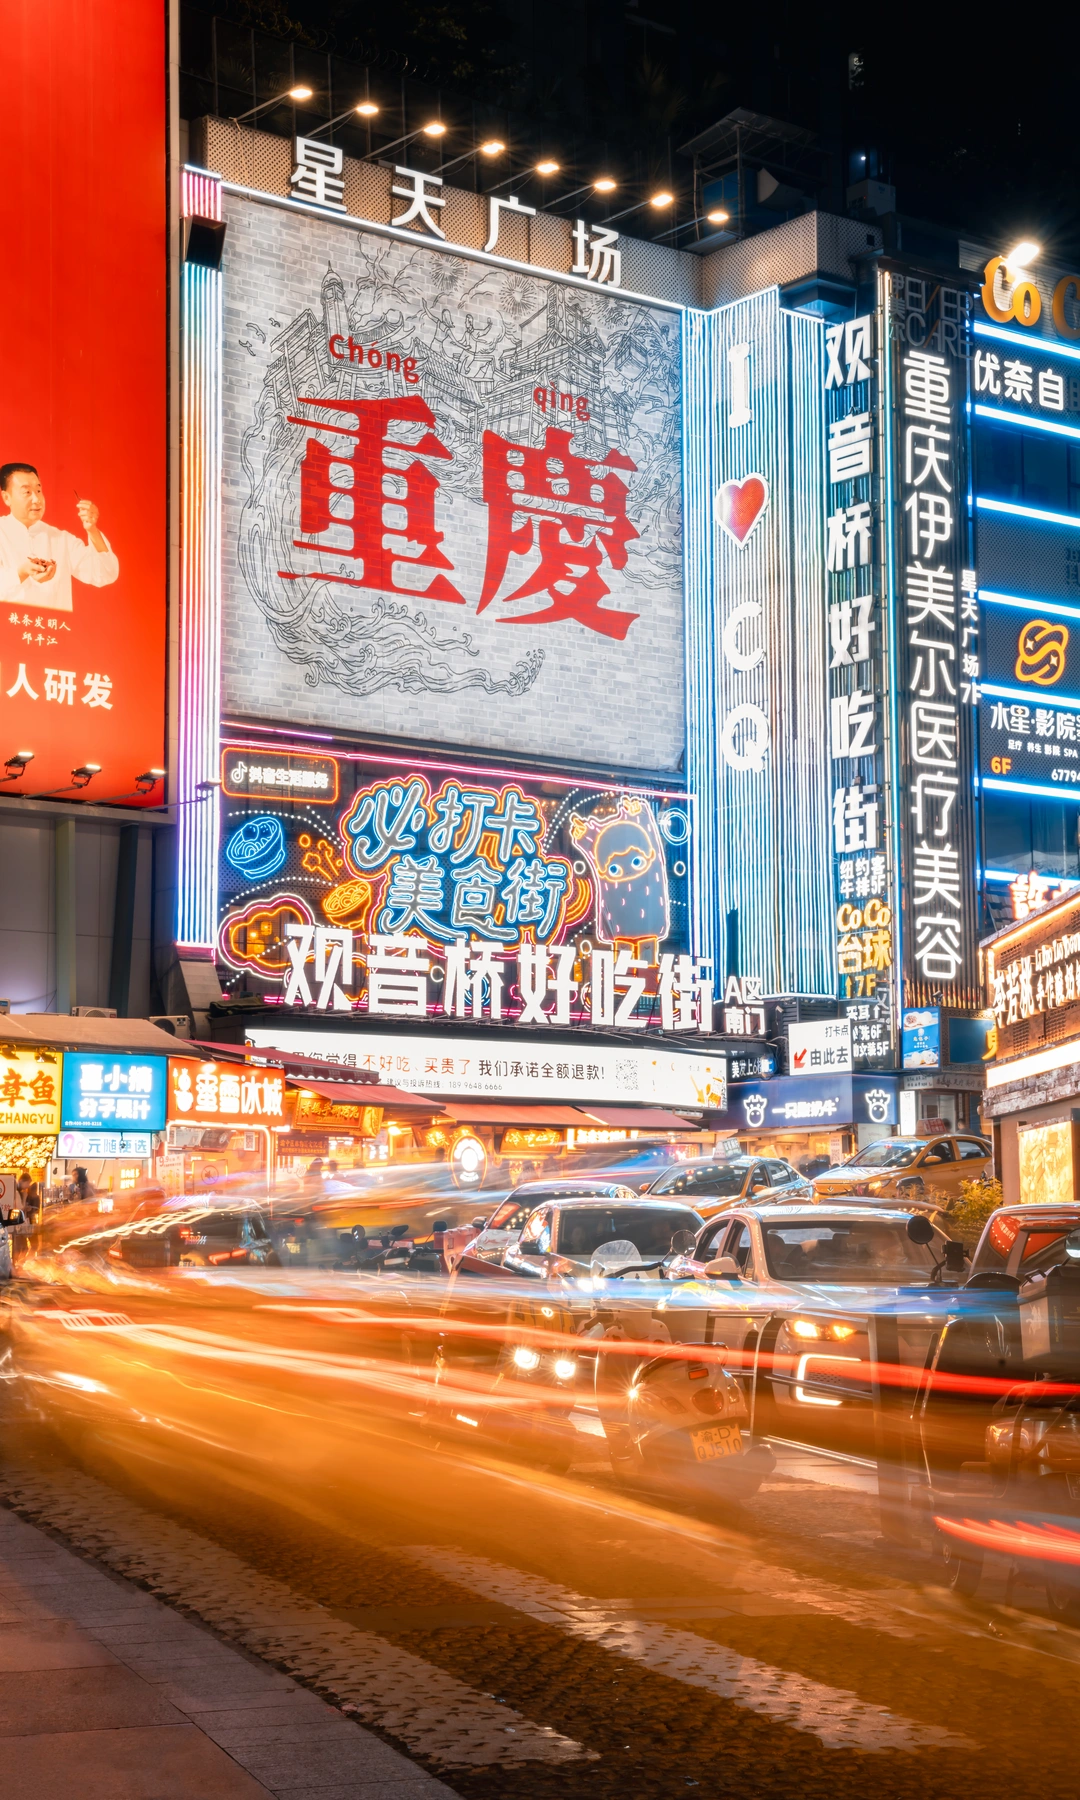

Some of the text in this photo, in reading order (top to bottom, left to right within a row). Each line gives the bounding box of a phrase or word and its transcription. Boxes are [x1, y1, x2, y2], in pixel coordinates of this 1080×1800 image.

[291, 136, 622, 288] 星天广场
[277, 396, 641, 641] 重慶
[825, 314, 877, 853] 观音桥好吃街
[8, 612, 71, 631] 辣条发明人
[961, 569, 979, 678] 星天广场
[22, 631, 58, 646] 邱平江
[903, 350, 963, 979] 重庆伊美尔医疗美容
[6, 663, 113, 710] 人研发
[960, 682, 982, 705] 7F
[990, 756, 1012, 775] 6F
[1064, 748, 1078, 759] SPA
[348, 780, 540, 869] 必打卡
[839, 856, 886, 881] 纽约客
[836, 930, 892, 974] 台球
[283, 922, 714, 1033] 观音桥好吃街
[724, 975, 765, 1006] A区
[855, 974, 877, 996] 7F
[724, 1006, 766, 1035] 南门
[825, 1025, 849, 1038] 打卡点
[810, 1046, 848, 1067] 由此去
[195, 1073, 283, 1117] 蜜雪冰城
[449, 1080, 461, 1089] 189
[79, 1097, 151, 1120] 分子果汁
